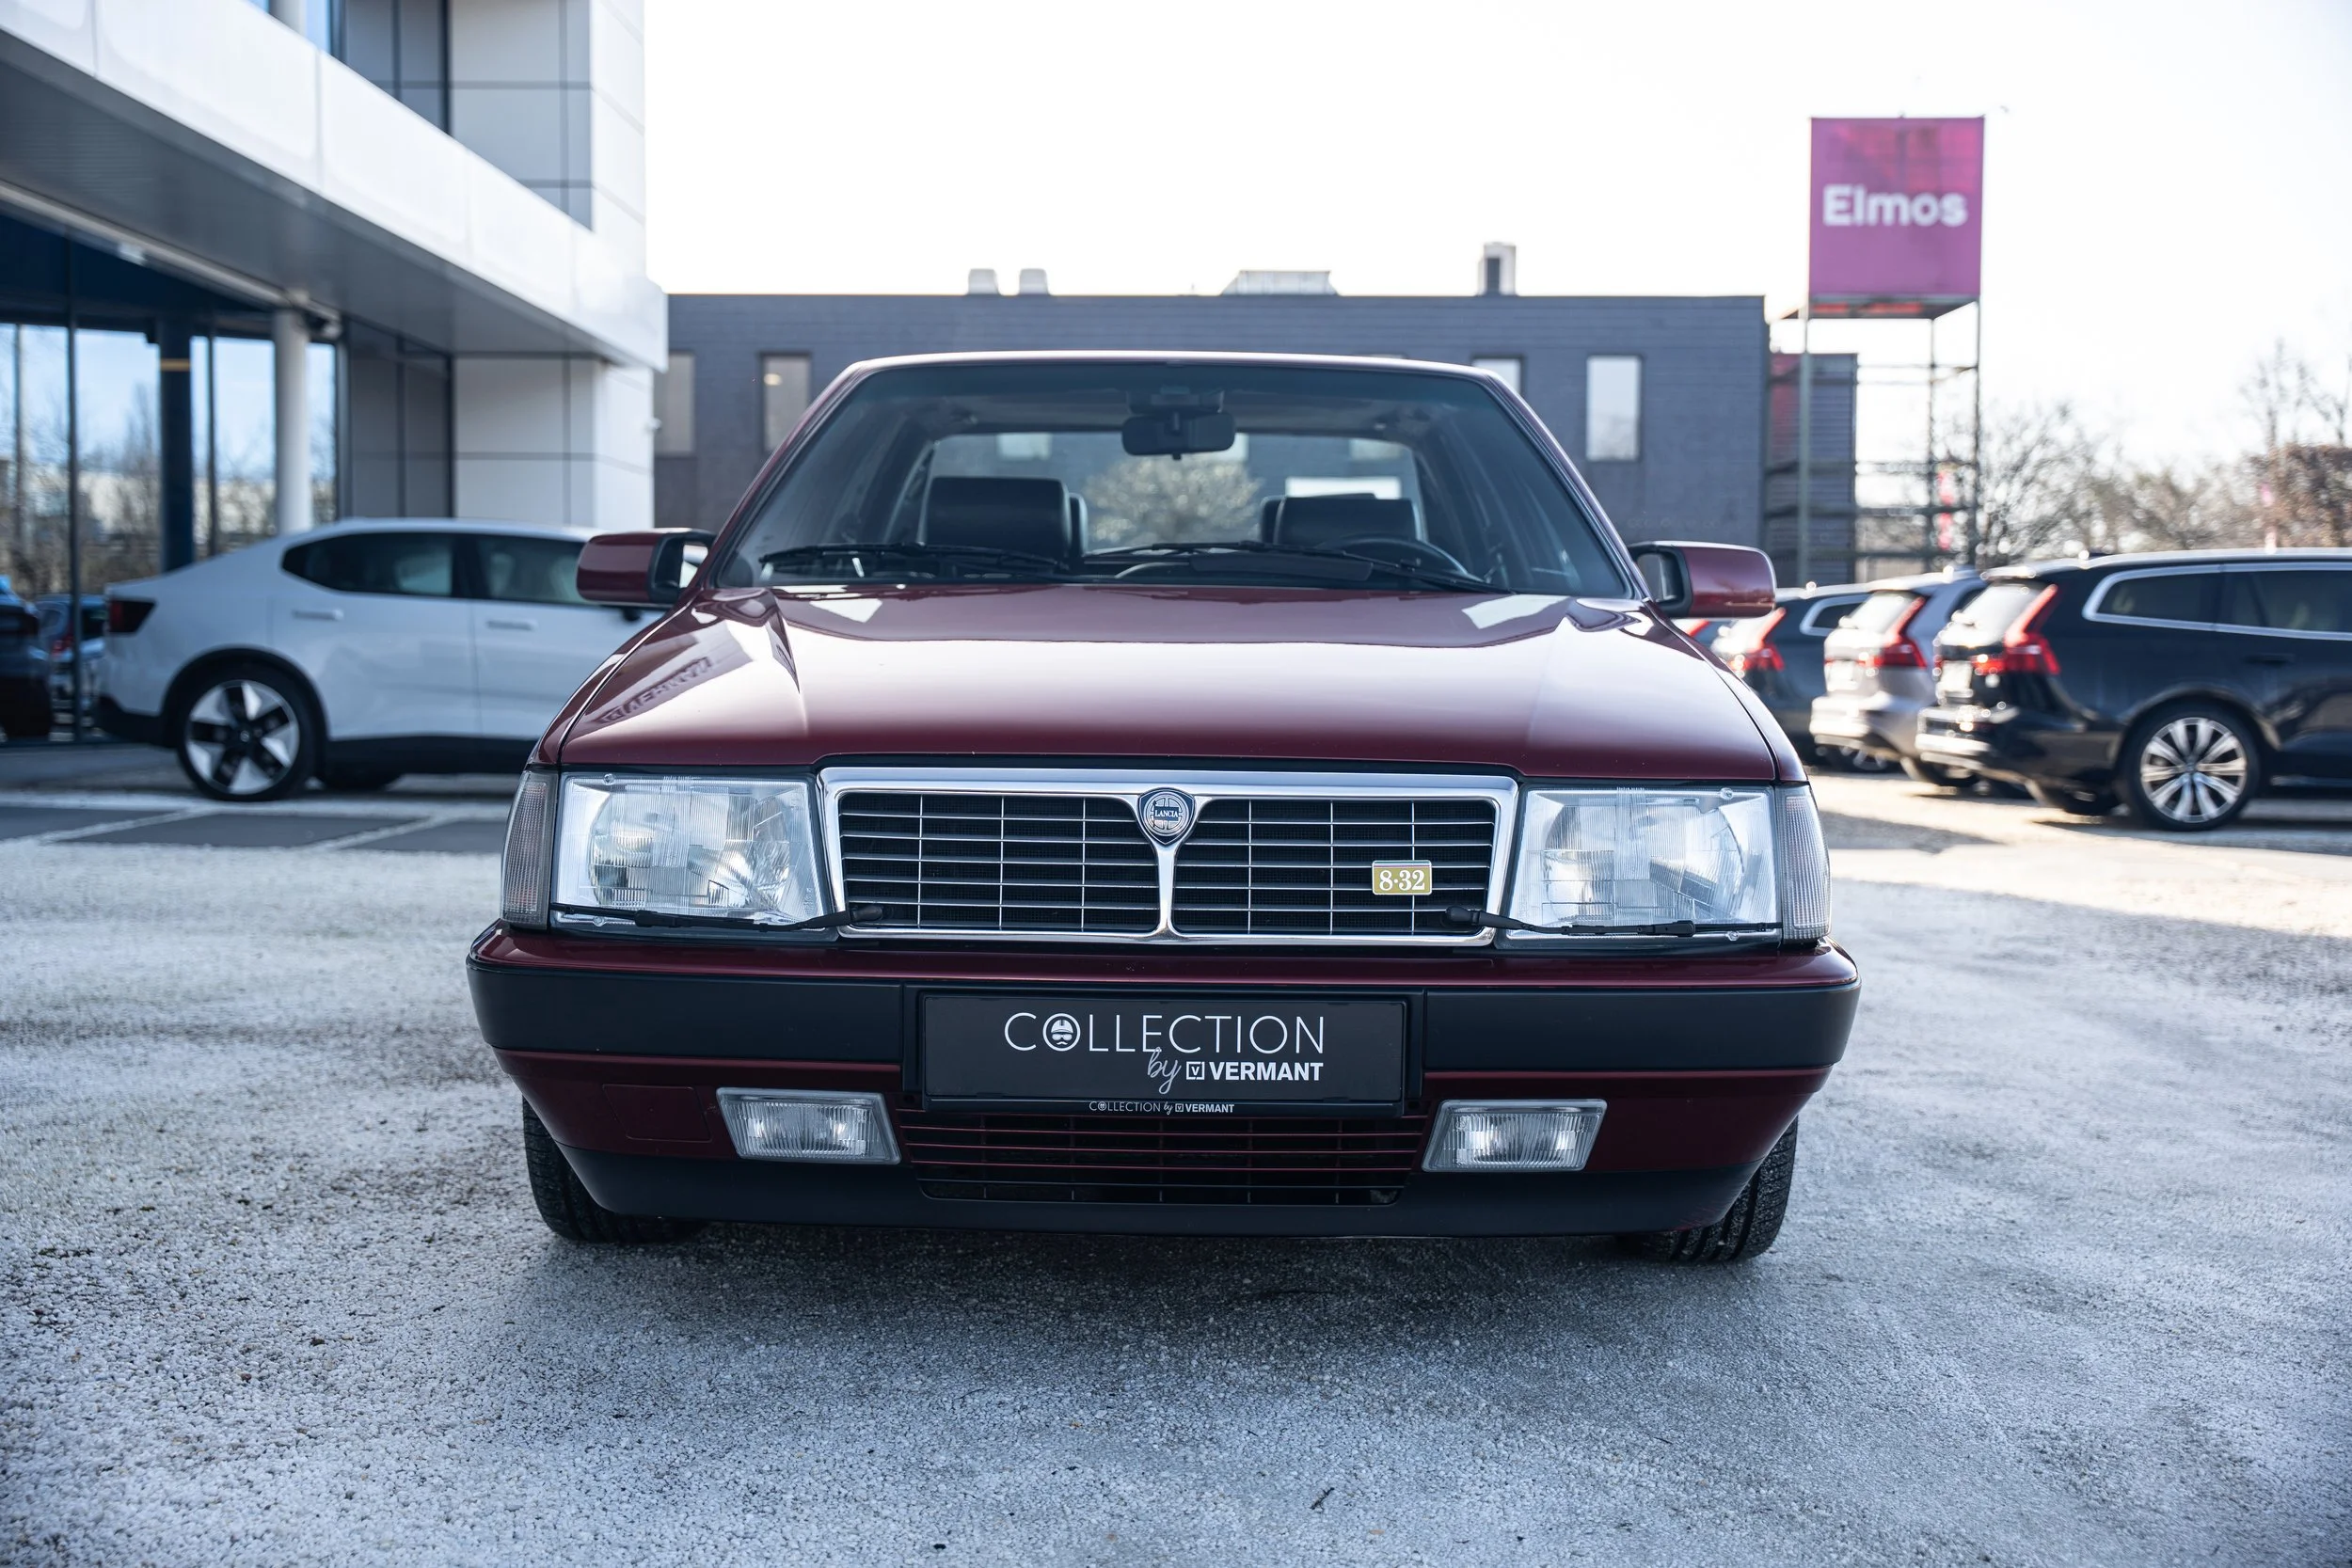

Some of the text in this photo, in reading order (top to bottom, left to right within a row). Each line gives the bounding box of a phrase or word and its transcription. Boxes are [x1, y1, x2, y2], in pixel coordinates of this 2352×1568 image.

[1822, 184, 1968, 227] Elmos
[1154, 809, 1179, 817] LANCIA
[1004, 1012, 1324, 1053] COLLECTION
[1147, 1046, 1182, 1095] by
[1209, 1061, 1324, 1081] VERMANT
[1089, 1101, 1161, 1112] COLLECTION
[1163, 1101, 1174, 1116] by
[1185, 1103, 1235, 1114] VERMANT
